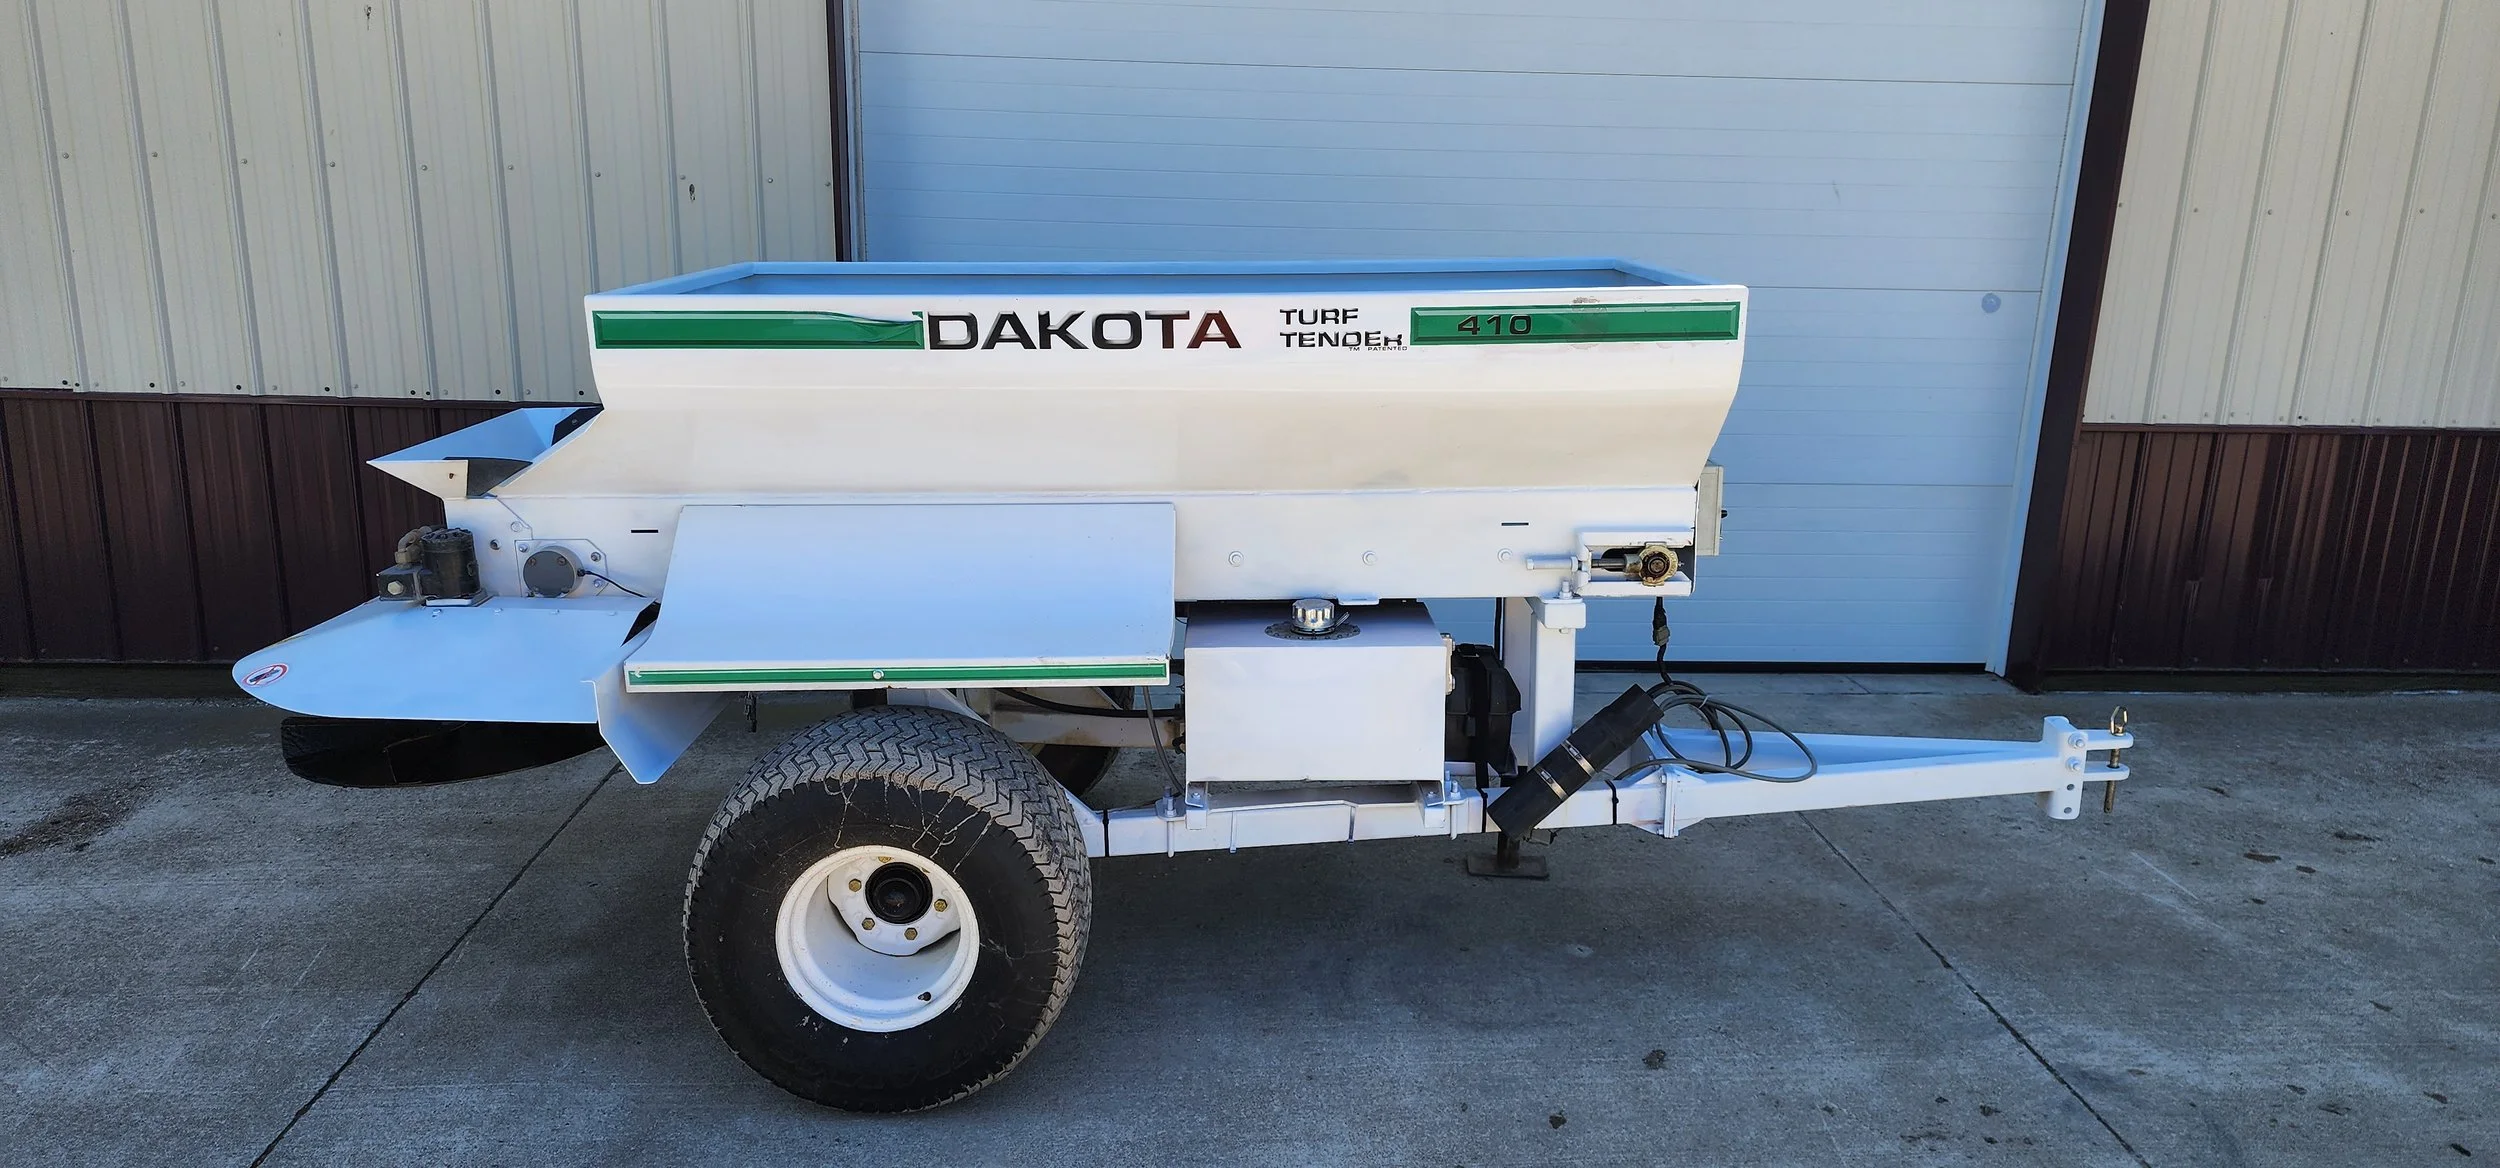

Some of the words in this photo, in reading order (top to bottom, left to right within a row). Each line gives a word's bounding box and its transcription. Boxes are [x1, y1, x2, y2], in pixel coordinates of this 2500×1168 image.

[1280, 308, 1358, 325] TURF
[1457, 314, 1532, 335] 410
[928, 310, 1242, 349] DAKOTA
